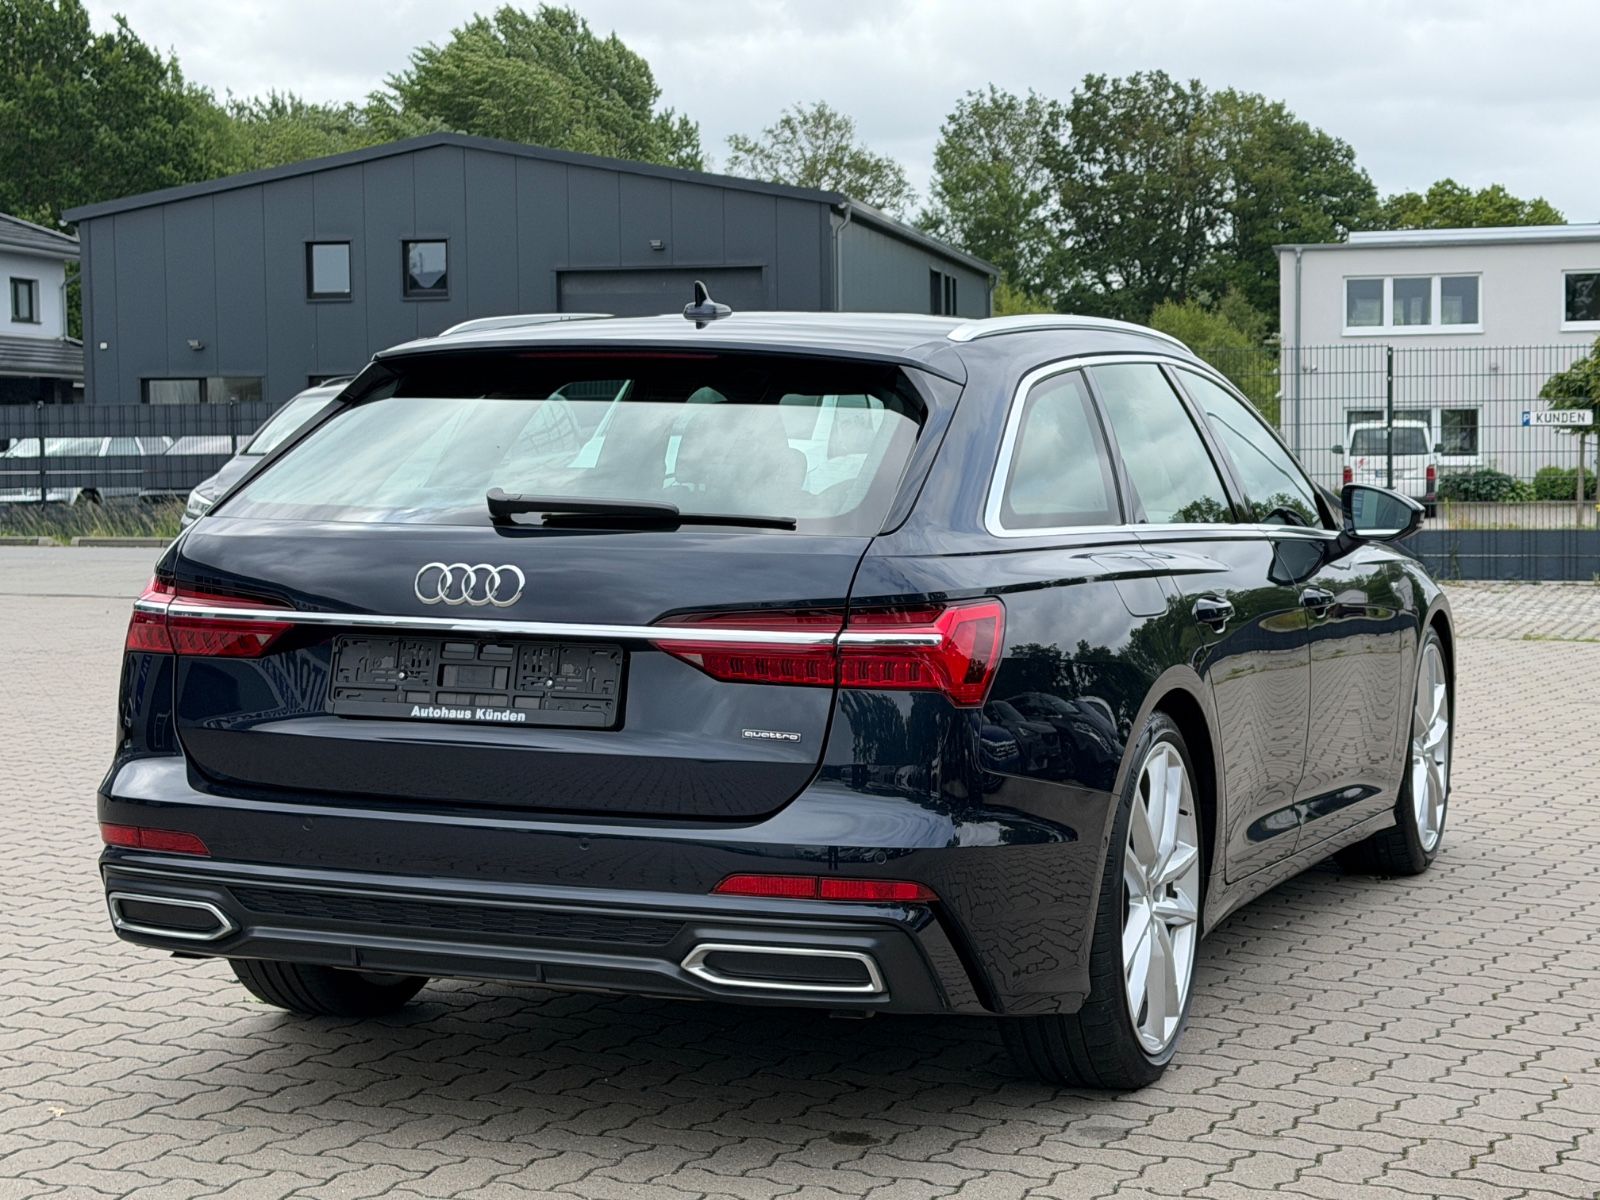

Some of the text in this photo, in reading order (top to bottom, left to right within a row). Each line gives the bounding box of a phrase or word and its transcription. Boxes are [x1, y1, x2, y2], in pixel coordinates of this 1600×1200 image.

[1536, 412, 1586, 423] KUNDEN
[410, 705, 526, 721] Autohaus Künden
[744, 731, 799, 740] quattro
